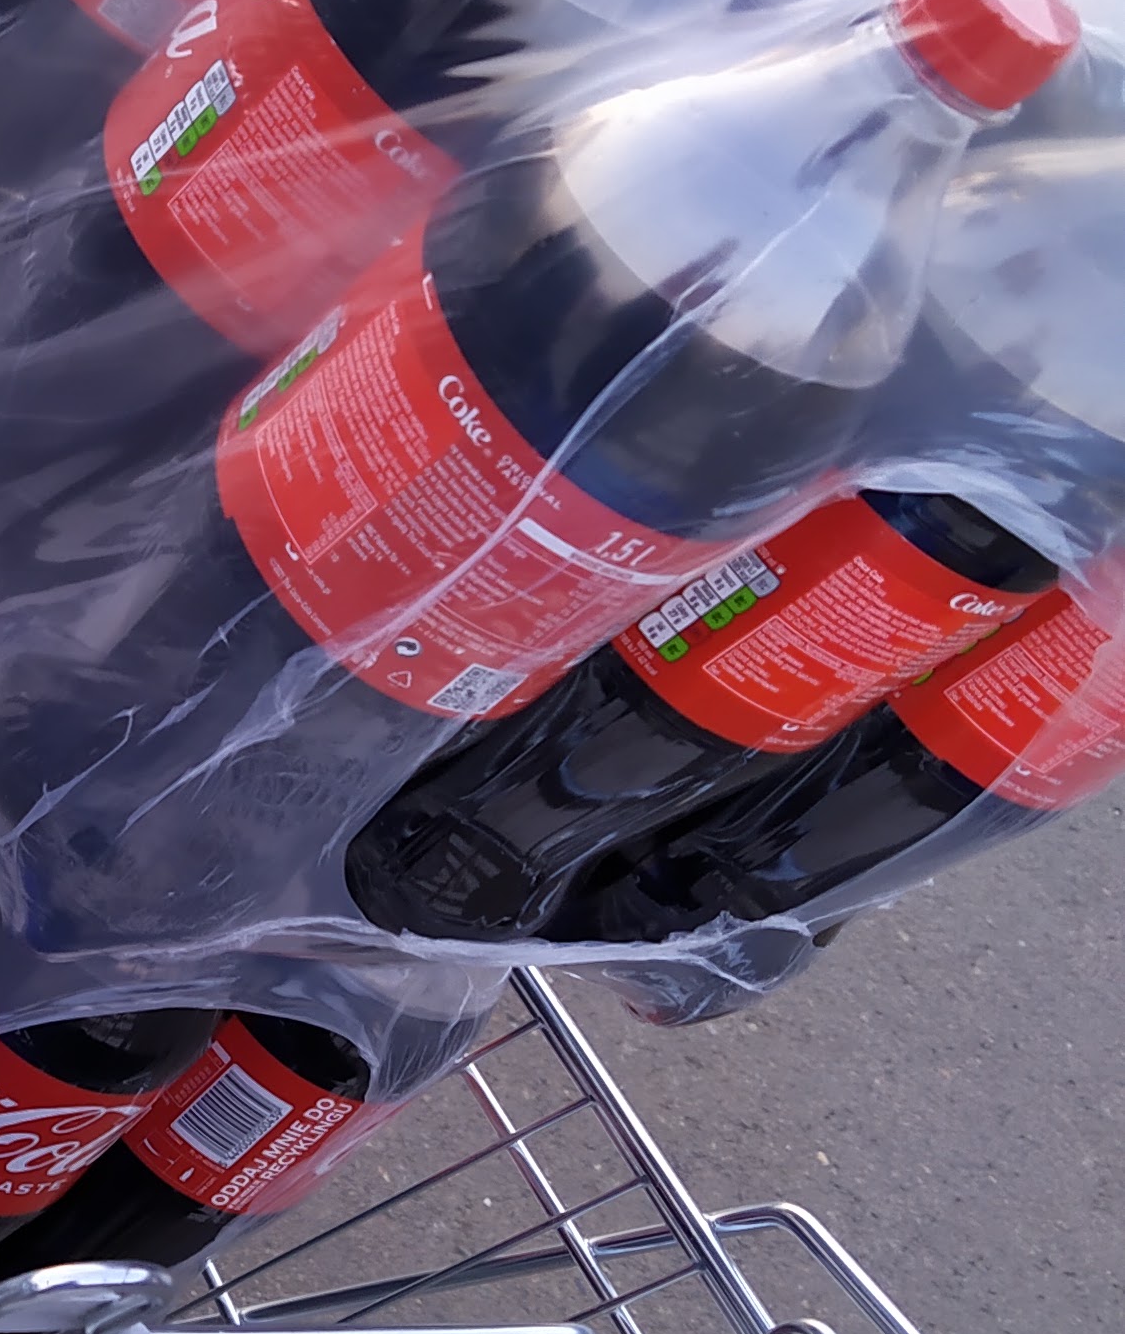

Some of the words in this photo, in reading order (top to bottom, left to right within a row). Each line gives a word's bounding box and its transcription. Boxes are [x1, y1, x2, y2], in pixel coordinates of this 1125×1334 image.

[438, 375, 492, 446] Coke
[949, 593, 1005, 616] Coke
[210, 1157, 269, 1207] ODDAJ
[262, 1119, 311, 1160] MNIE
[303, 1097, 336, 1121] DO
[259, 1102, 354, 1182] RECYKLINGU
